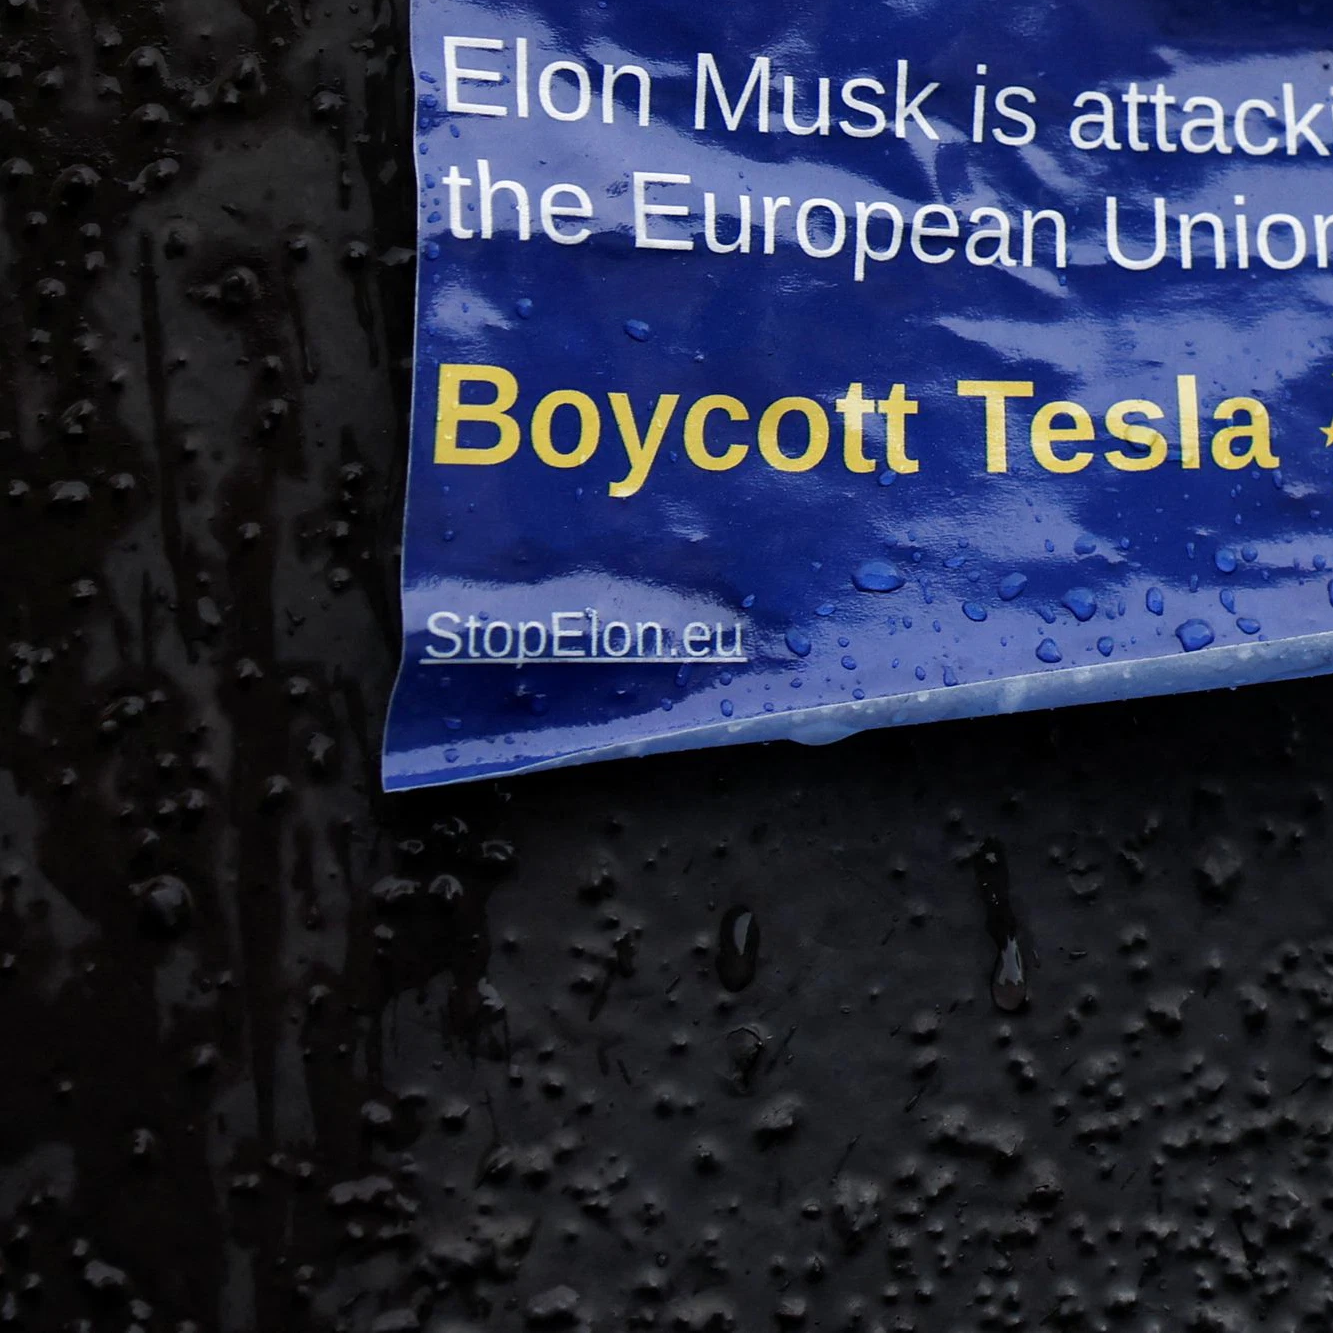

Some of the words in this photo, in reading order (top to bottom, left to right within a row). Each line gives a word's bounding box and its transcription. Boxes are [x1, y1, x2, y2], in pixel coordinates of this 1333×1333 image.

[442, 35, 651, 127] Elon
[695, 52, 940, 141] Musk
[973, 64, 1037, 146] is
[441, 159, 593, 245] the
[632, 171, 1067, 282] European
[433, 363, 920, 498] Boycott
[956, 374, 1280, 474] Tesla
[423, 610, 744, 668] StopElon.eu
